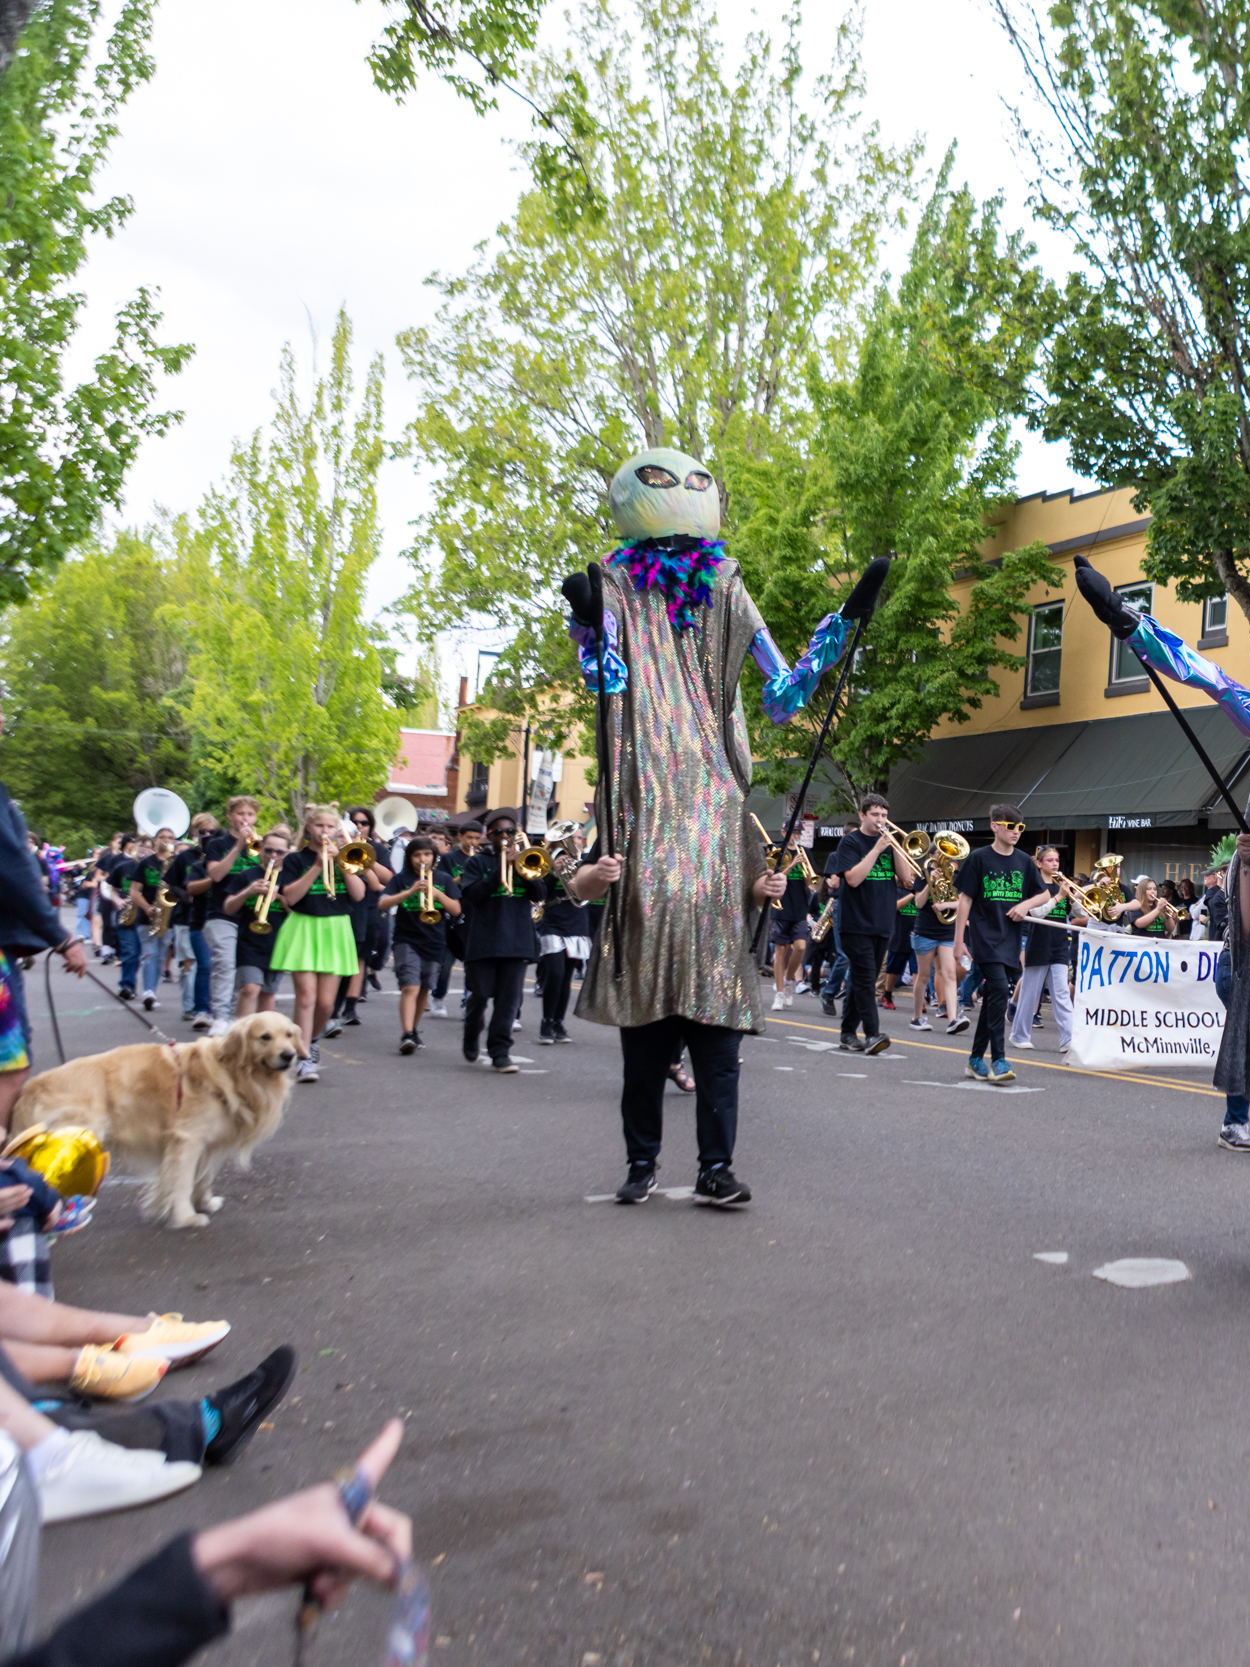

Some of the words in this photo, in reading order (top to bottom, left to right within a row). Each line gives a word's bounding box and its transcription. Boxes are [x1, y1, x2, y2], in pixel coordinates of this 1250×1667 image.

[929, 821, 948, 833] DADDY
[948, 820, 974, 832] DONUTS
[1108, 815, 1126, 829] HiFi
[1126, 819, 1140, 828] WINE
[1140, 818, 1152, 827] BAR
[1080, 941, 1170, 993] PATTON
[1085, 1007, 1148, 1028] MIDDLE
[1154, 1011, 1225, 1029] SCHOOL
[1120, 1036, 1216, 1057] McMinnville,
